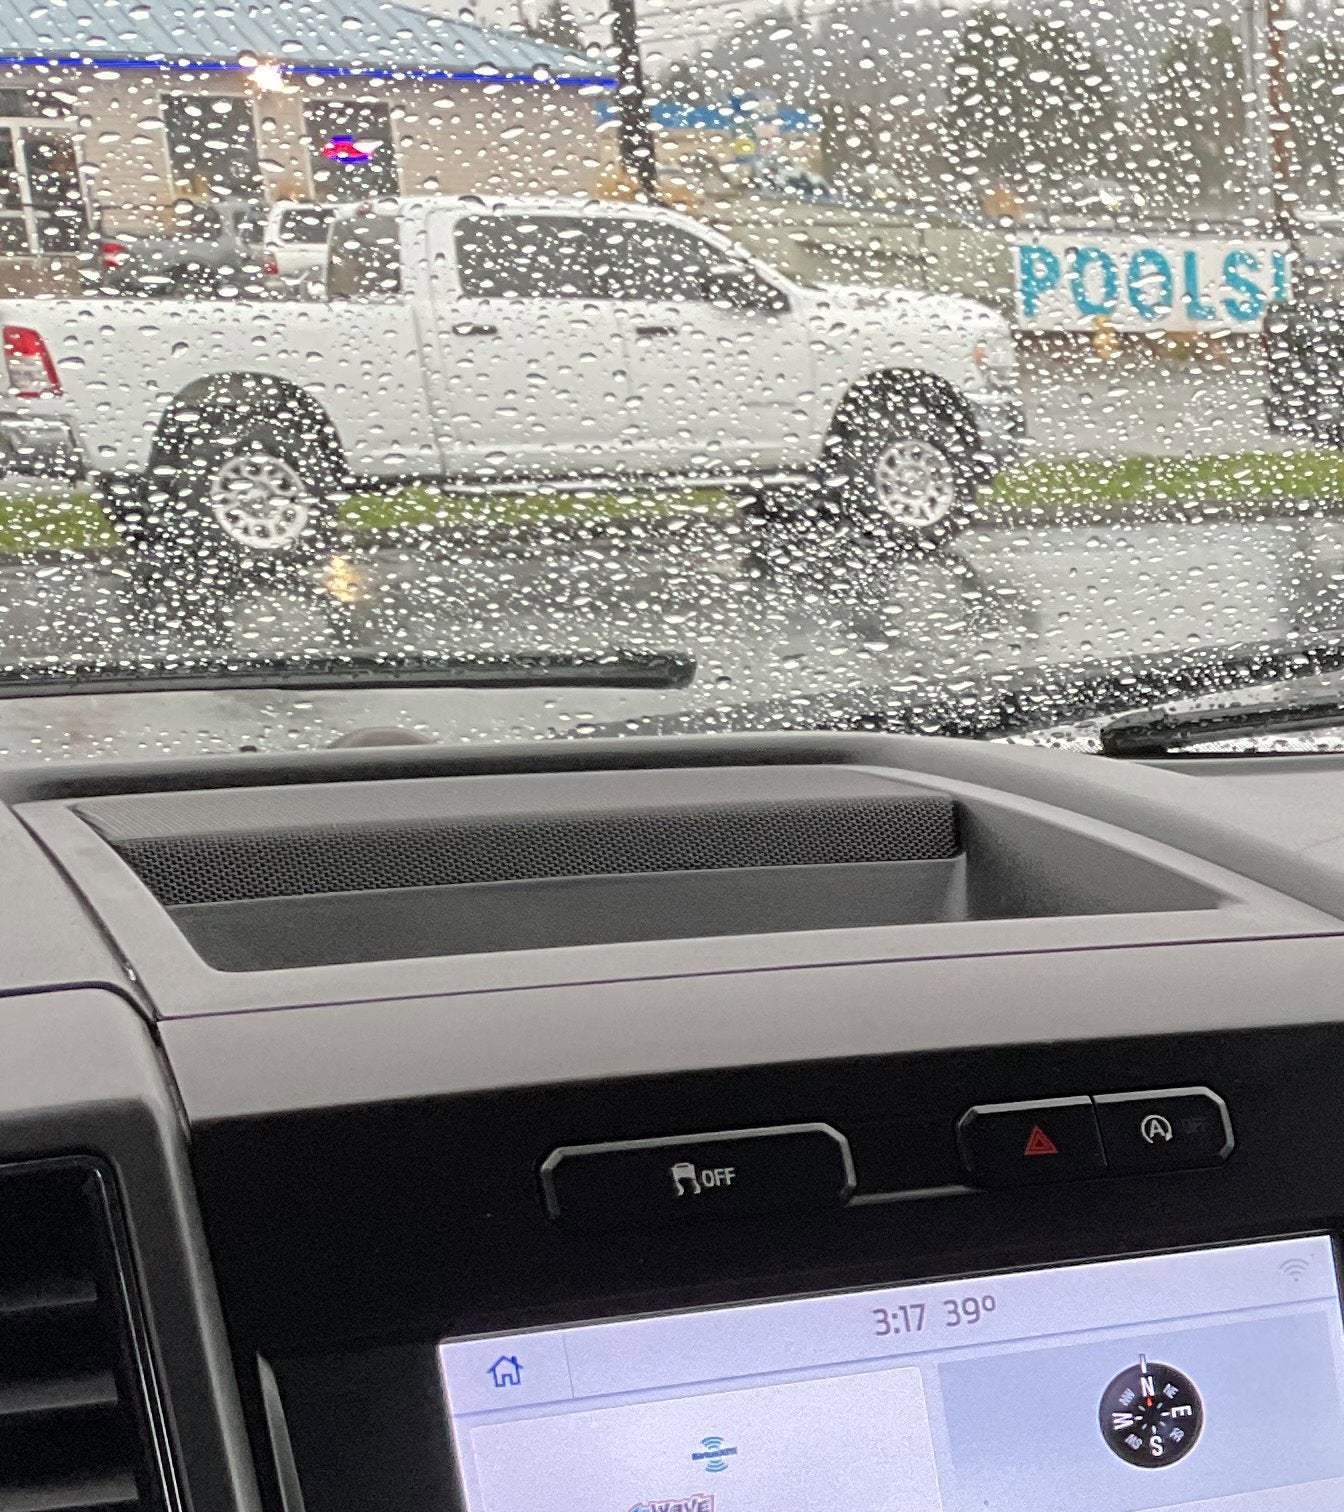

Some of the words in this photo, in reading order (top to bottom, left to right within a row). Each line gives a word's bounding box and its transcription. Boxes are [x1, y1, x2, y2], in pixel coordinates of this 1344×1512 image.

[701, 1166, 736, 1188] OFF
[872, 1303, 926, 1336] 3:17
[1141, 1376, 1155, 1397] N
[1171, 1405, 1192, 1418] E
[1150, 1435, 1164, 1456] S
